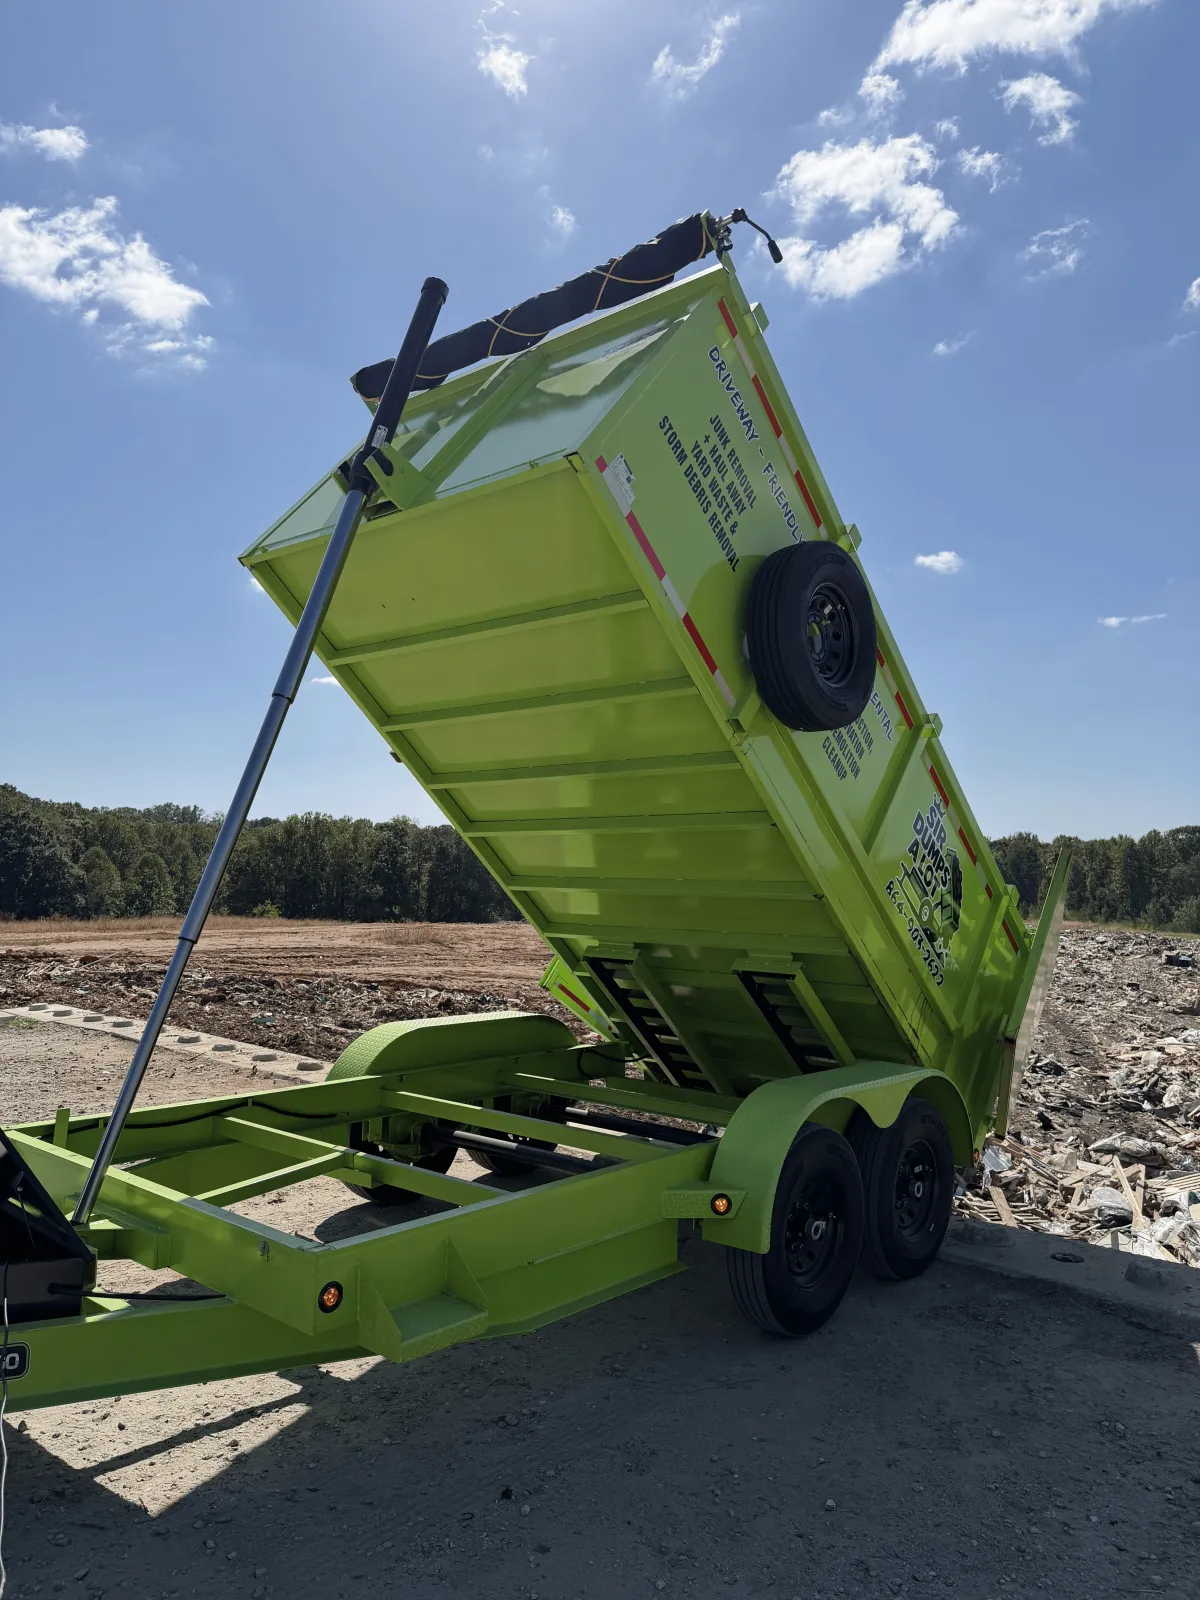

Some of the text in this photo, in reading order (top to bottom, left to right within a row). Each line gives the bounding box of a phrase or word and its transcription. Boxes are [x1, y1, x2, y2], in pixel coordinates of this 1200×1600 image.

[708, 345, 759, 441] DRIVEWAY
[659, 415, 739, 572] STORM DEBRIS REMOVAL
[691, 440, 739, 536] YARD WASTE &
[704, 434, 746, 516] + HAUL AWAY
[710, 415, 757, 510] JUNK REMOVAL
[830, 728, 860, 780] EMOLITION
[869, 690, 893, 743] ENTAL
[822, 736, 847, 780] CLEANUP
[912, 809, 951, 888] DUMPS
[926, 804, 947, 855] SIR
